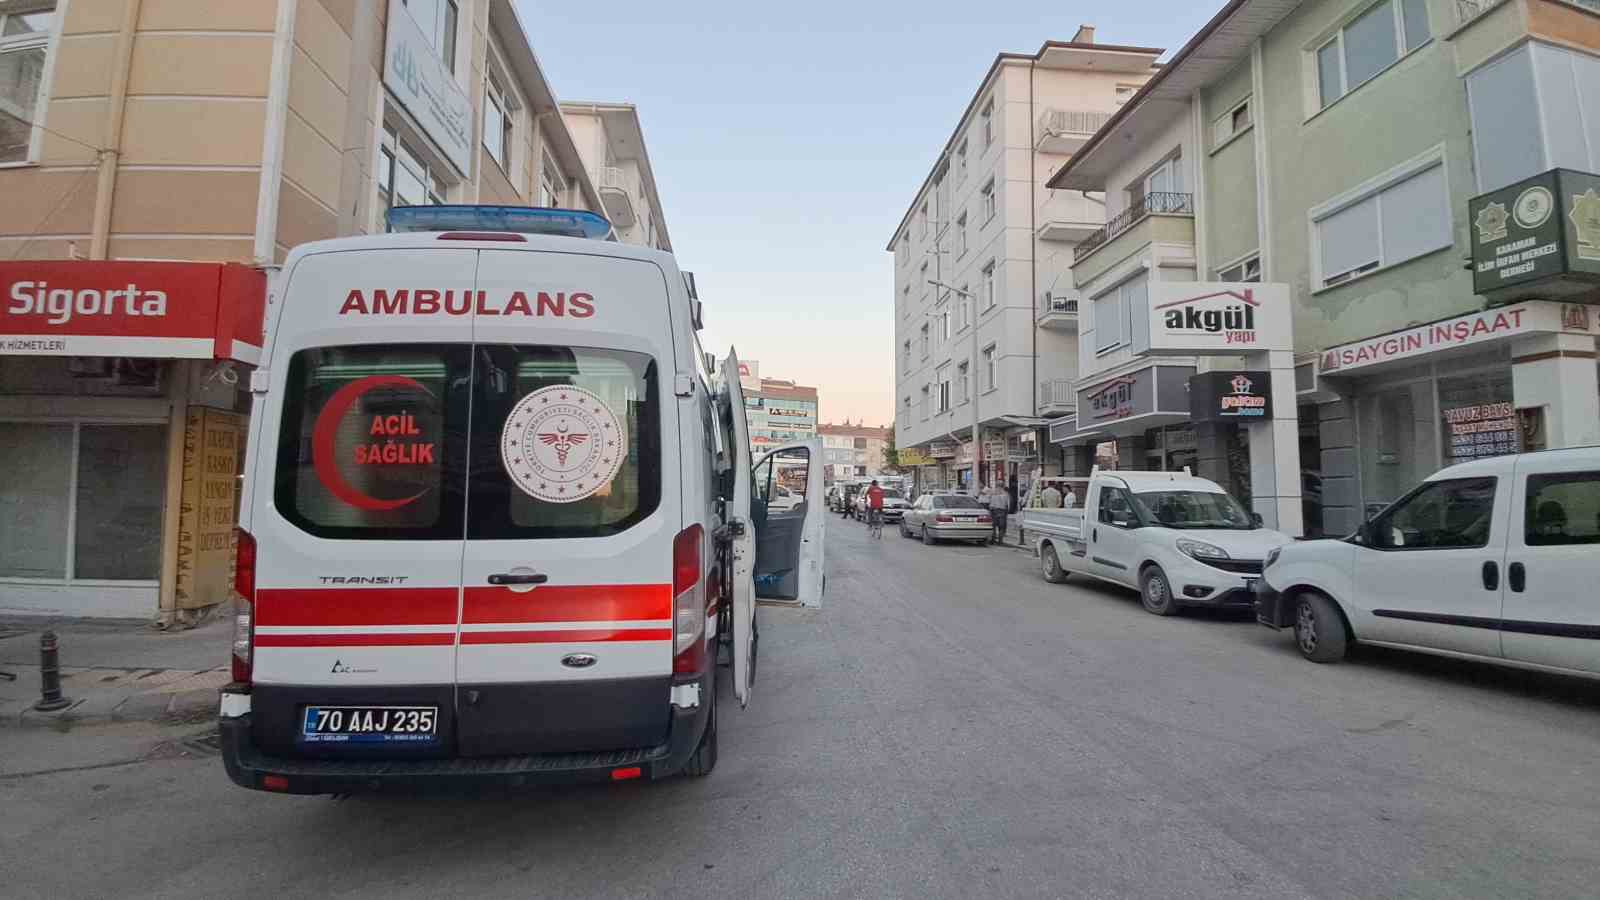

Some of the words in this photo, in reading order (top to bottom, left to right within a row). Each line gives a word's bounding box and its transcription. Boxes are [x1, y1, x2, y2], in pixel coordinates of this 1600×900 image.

[8, 280, 168, 325] Sigorta
[339, 289, 595, 318] AMBULANS
[1164, 304, 1254, 332] akgül
[7, 339, 66, 351] HİZMETLERİ
[1225, 330, 1256, 344] yapı
[1341, 333, 1423, 365] SAYGIN
[1428, 308, 1527, 345] İNŞAAT
[370, 409, 420, 435] ACİL
[354, 438, 434, 464] SAĞLIK
[319, 576, 409, 584] TRANSIT
[317, 710, 343, 732] 70
[348, 710, 389, 732] AAJ
[392, 710, 433, 732] 235
